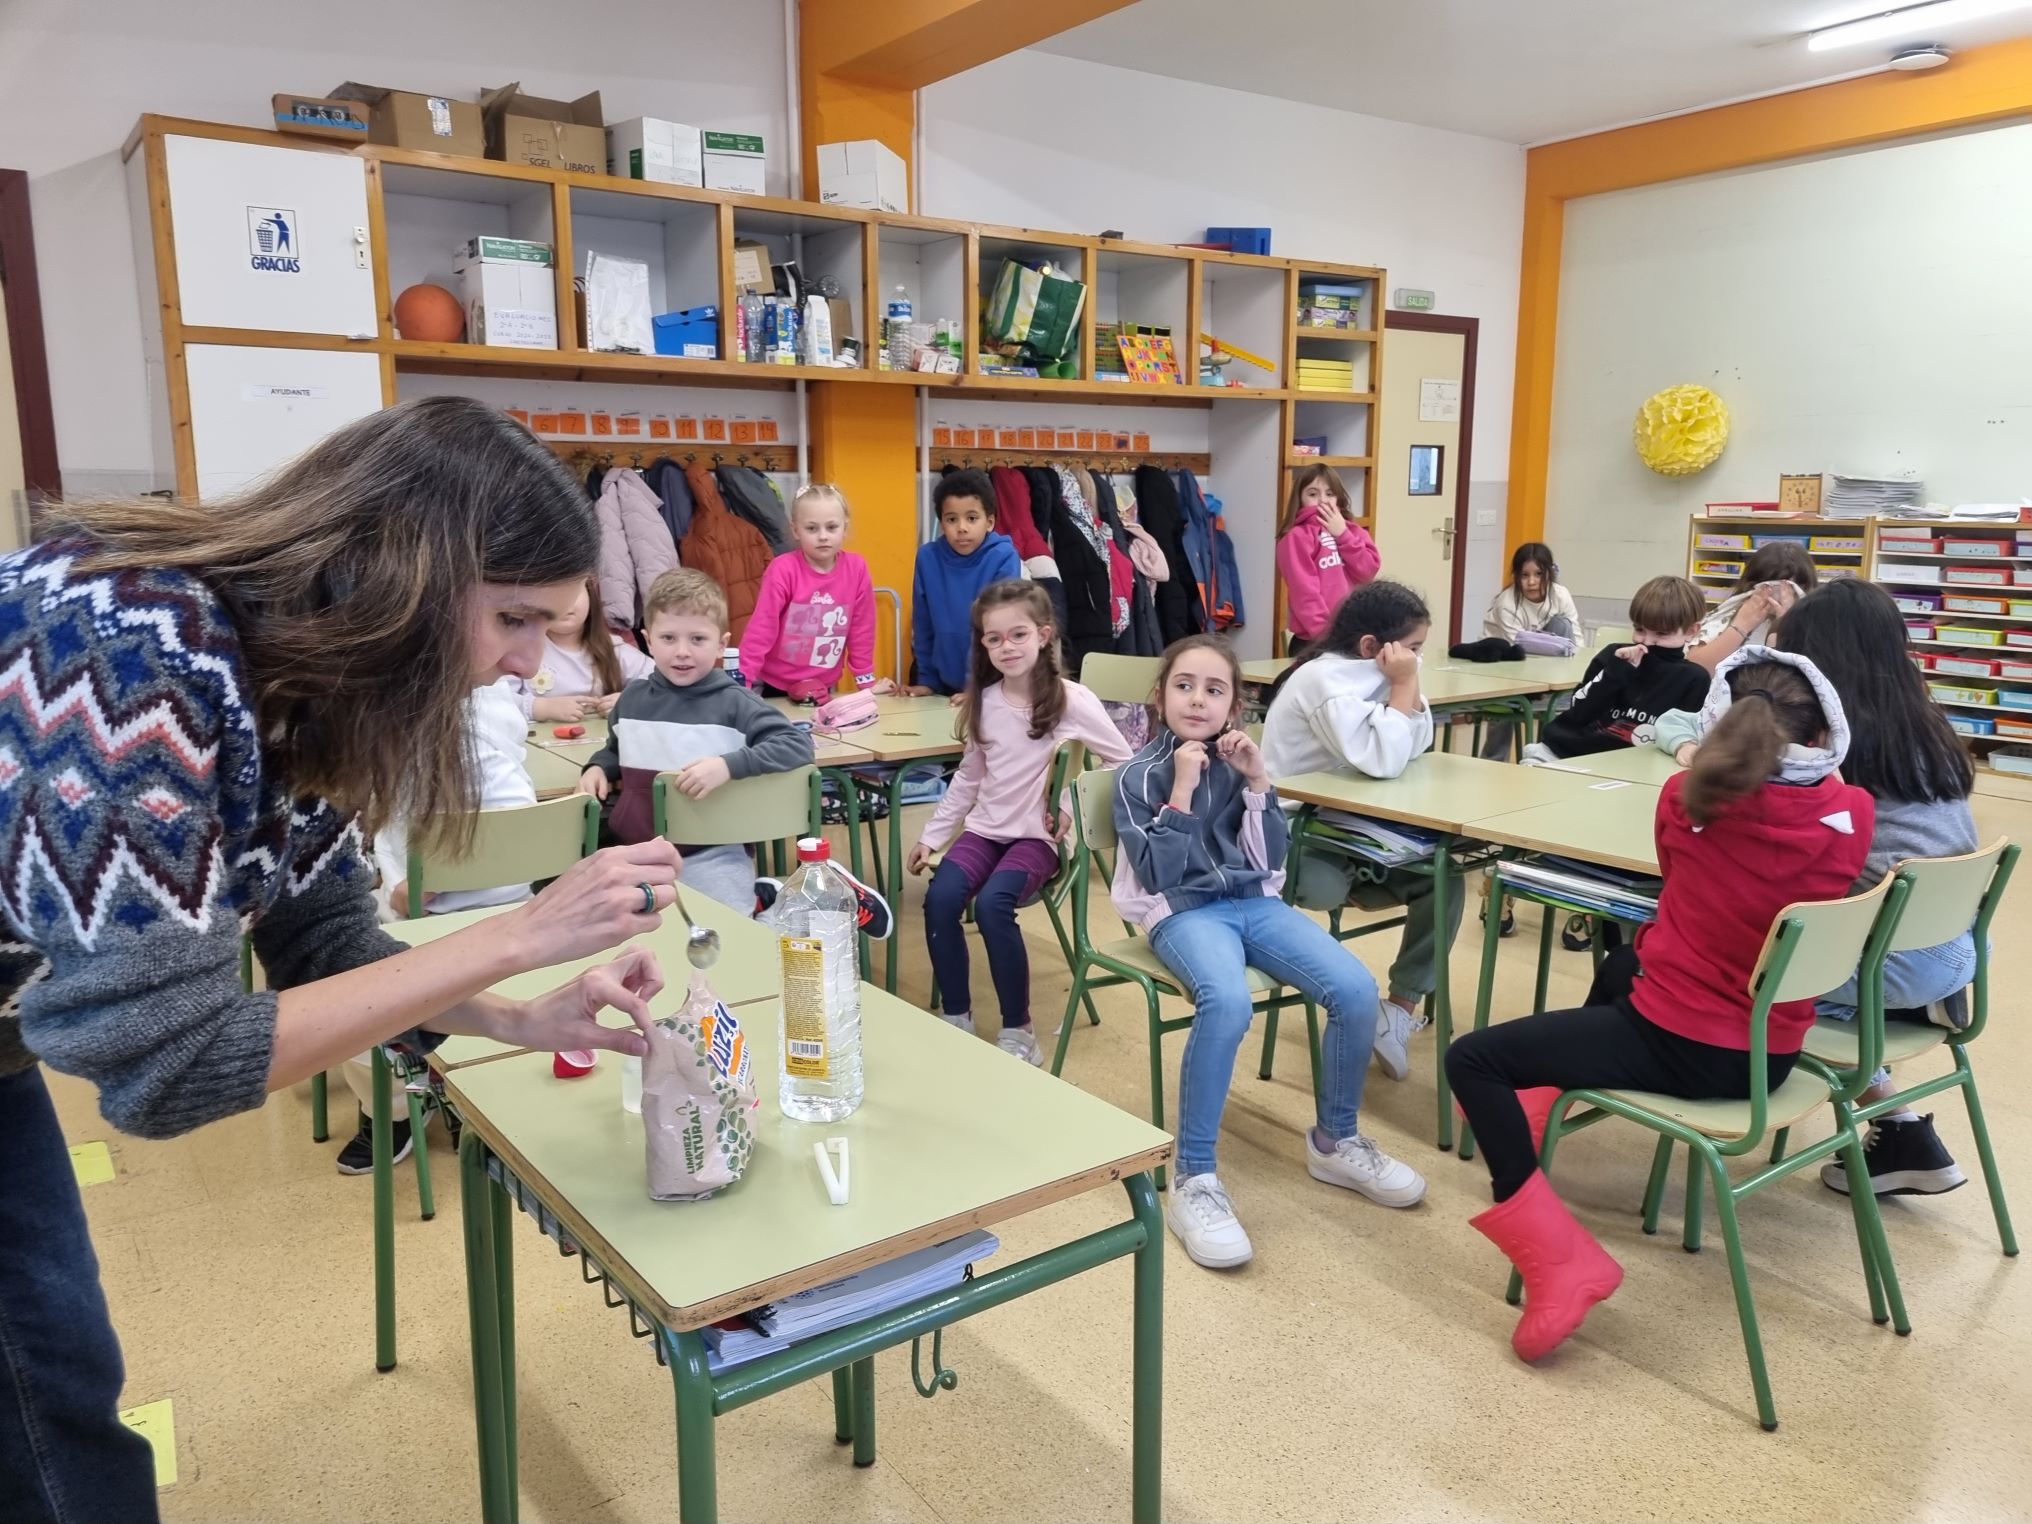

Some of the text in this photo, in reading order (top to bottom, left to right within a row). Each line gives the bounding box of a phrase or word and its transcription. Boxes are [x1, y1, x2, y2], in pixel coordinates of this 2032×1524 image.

[528, 157, 596, 174] SGEL LIBROS
[251, 256, 301, 273] GRACIAS
[1407, 296, 1428, 306] SALIDA
[270, 388, 311, 397] AYUDANTE
[567, 416, 577, 431] 7
[598, 416, 607, 433] 8
[708, 422, 722, 438] 12
[735, 424, 749, 440] 13
[1319, 551, 1344, 569] adi
[689, 1106, 705, 1172] NATURAL
[682, 1127, 696, 1175] LIMPIEZA
